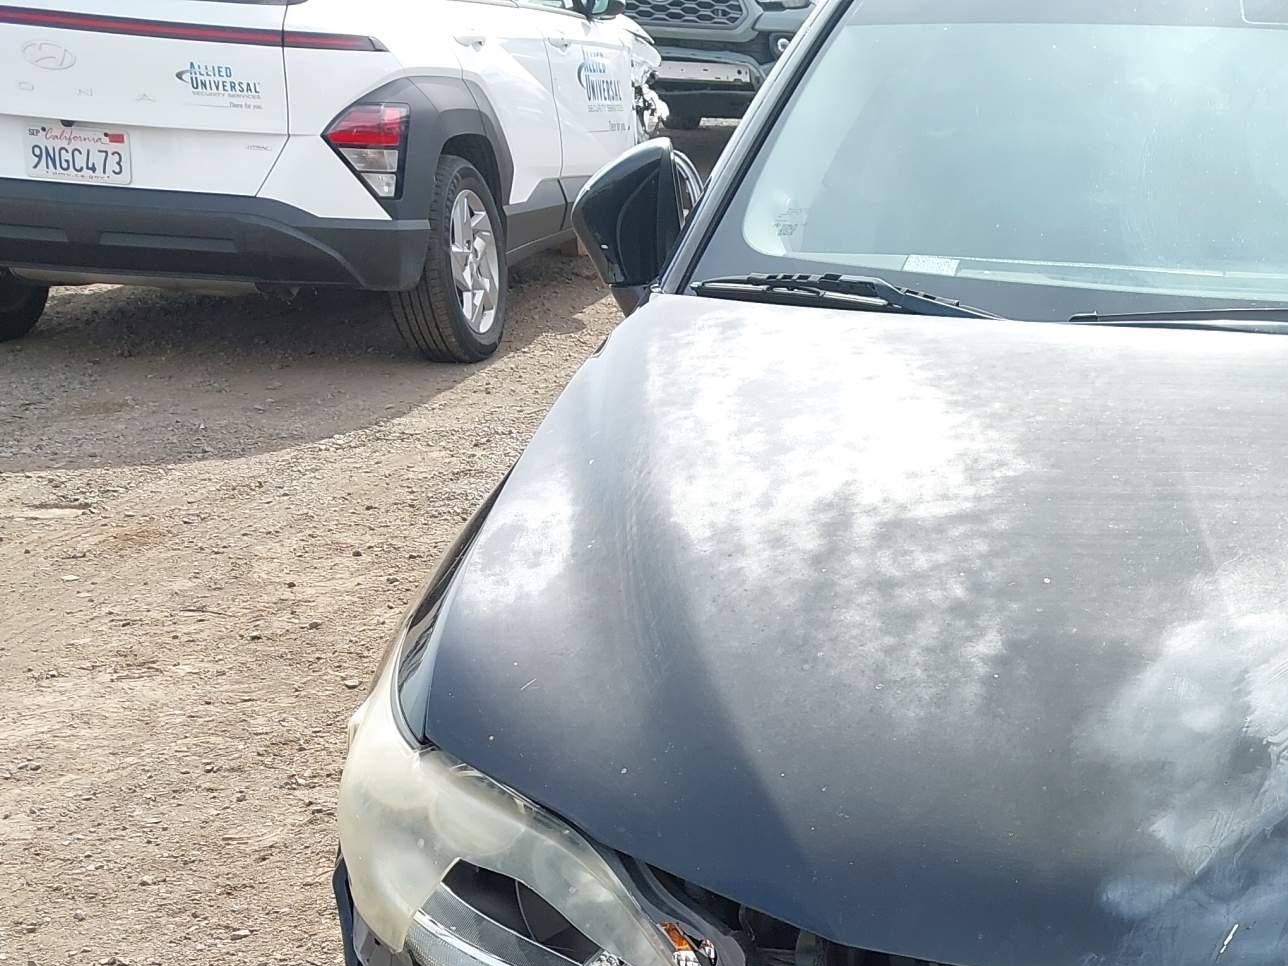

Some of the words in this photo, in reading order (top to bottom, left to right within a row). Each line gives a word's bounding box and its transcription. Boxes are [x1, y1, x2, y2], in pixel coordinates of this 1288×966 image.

[189, 61, 233, 78] ALLIED
[190, 76, 260, 94] UNIVERSAL
[585, 74, 622, 101] UNIVERSAL
[45, 128, 104, 145] California
[31, 144, 123, 175] 9NGC473
